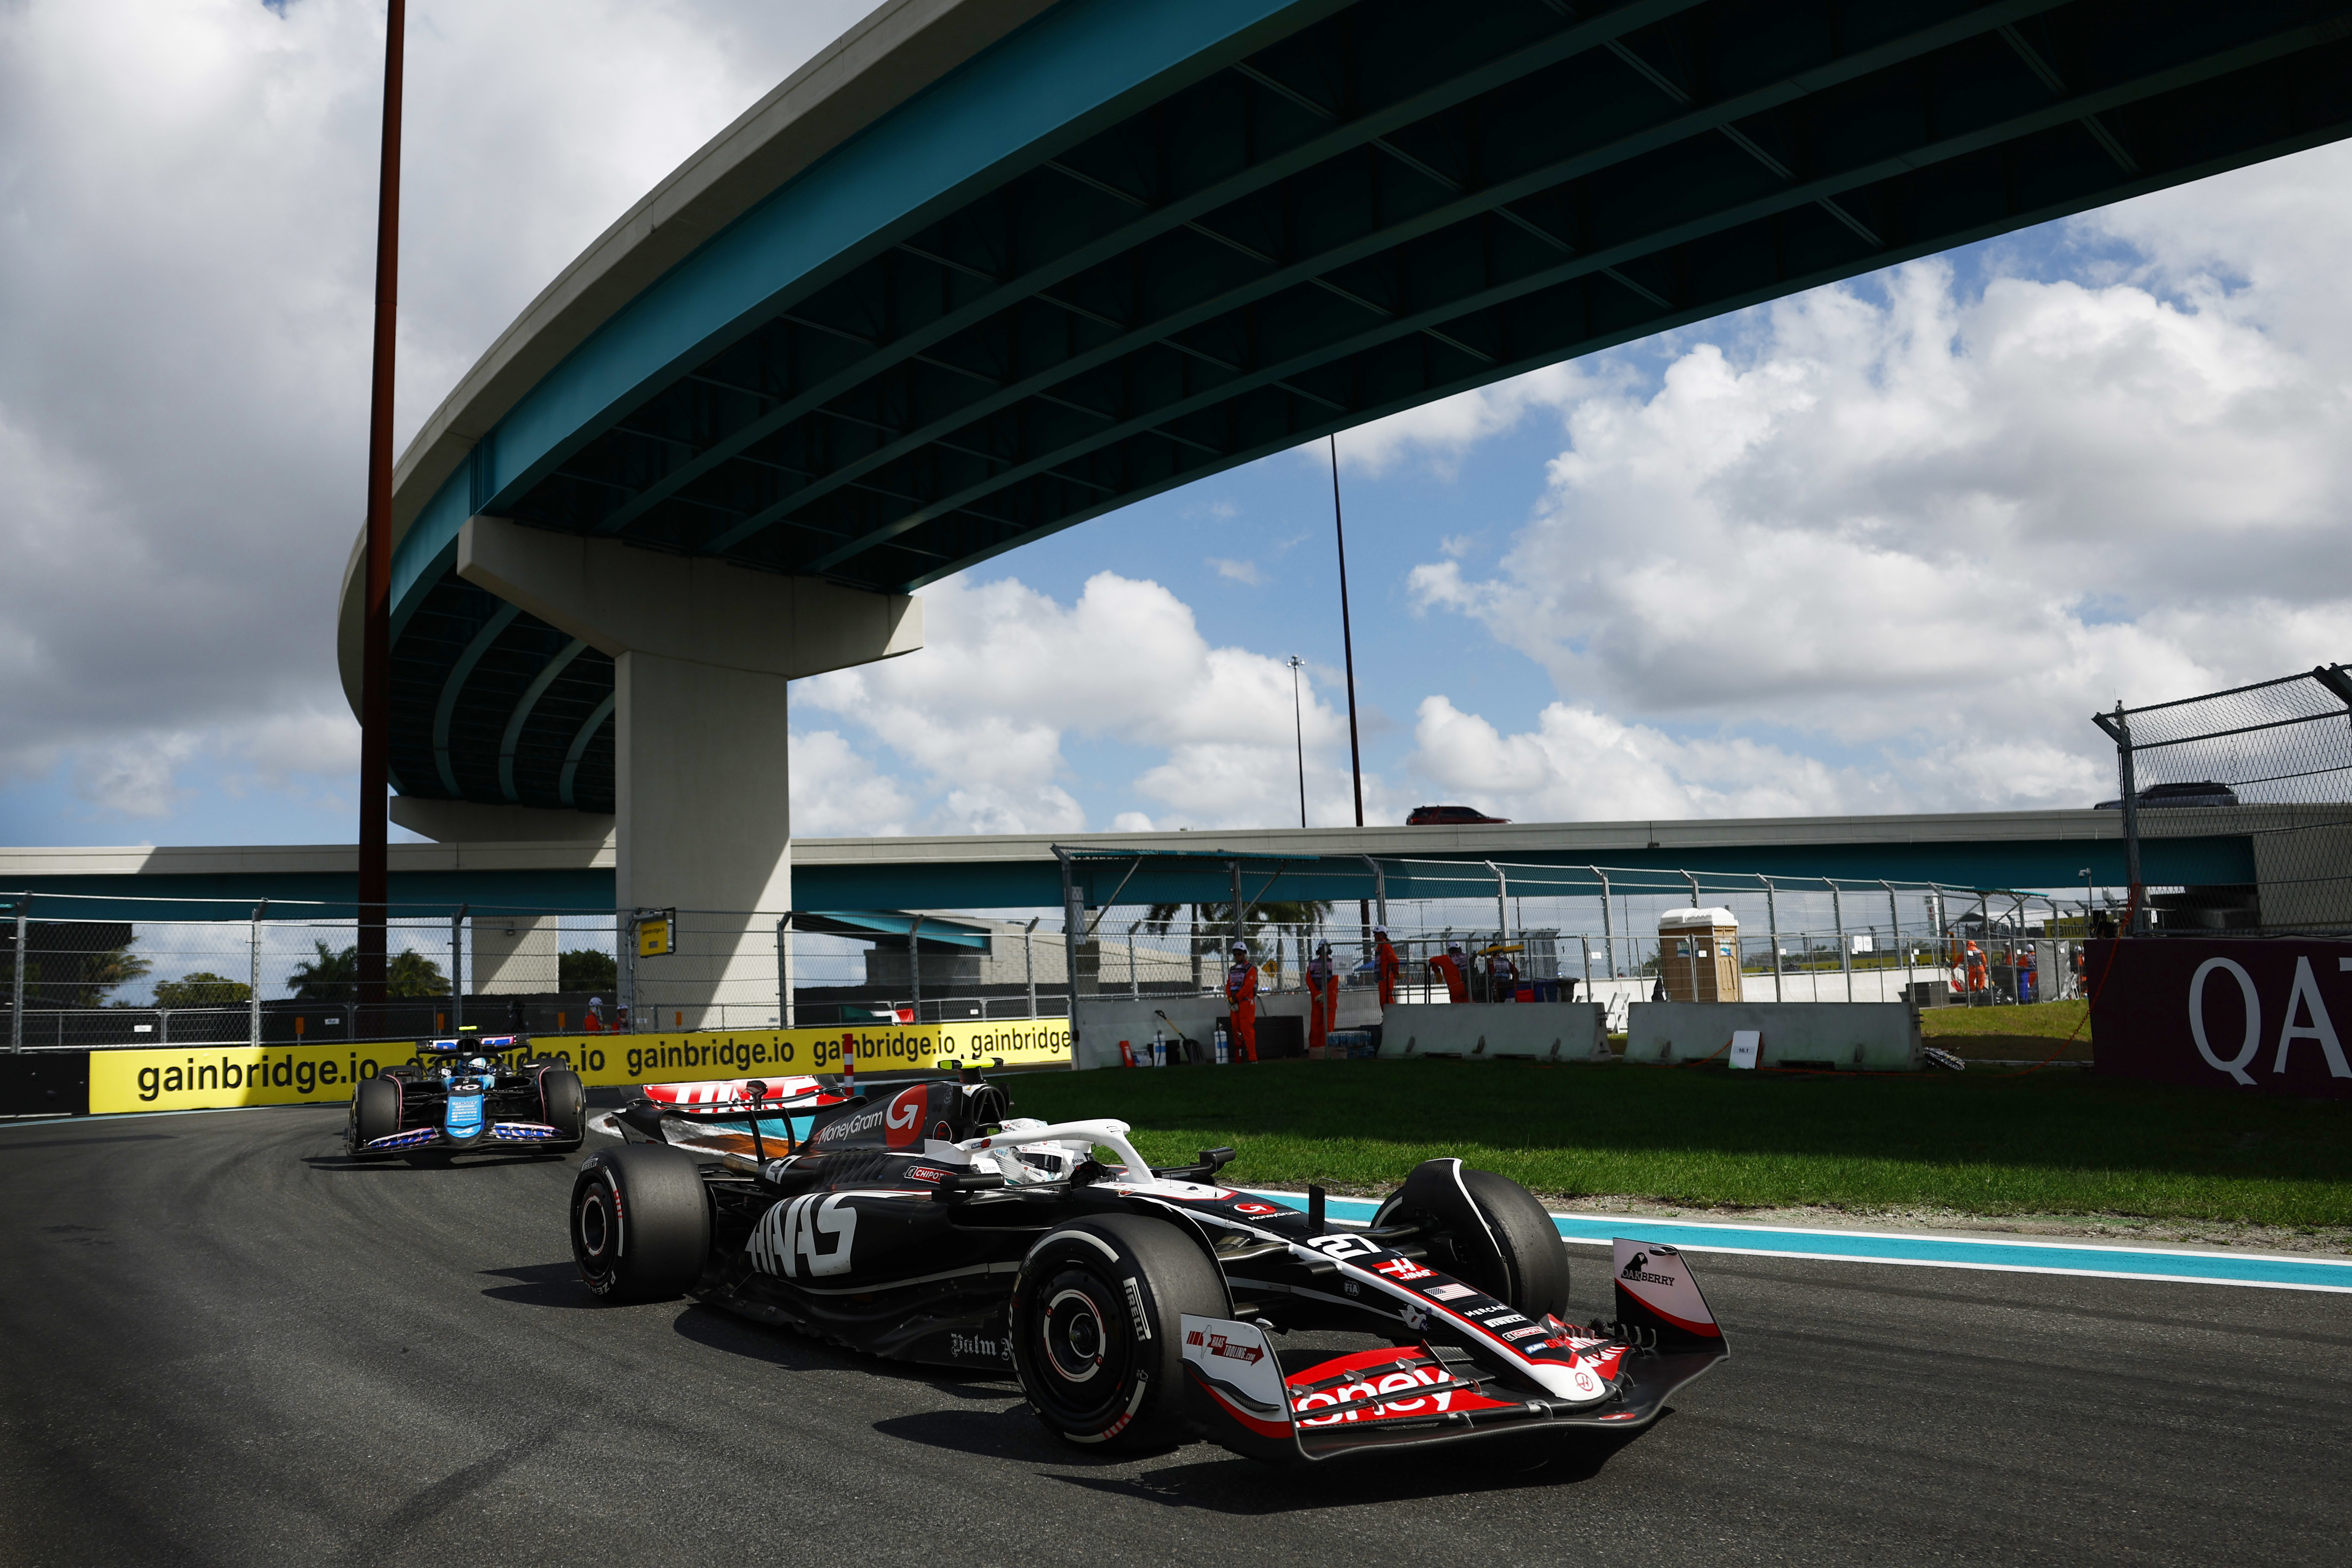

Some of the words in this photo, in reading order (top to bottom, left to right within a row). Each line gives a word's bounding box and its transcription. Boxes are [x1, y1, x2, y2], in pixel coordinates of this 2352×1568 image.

[627, 1037, 794, 1077] gainbridge.io
[138, 1053, 378, 1101] gainbridge.io
[817, 1110, 883, 1145] MoneyGram
[581, 1157, 598, 1172] PIRELLI
[917, 1169, 942, 1180] CHIPOT
[1248, 1210, 1300, 1221] MoneyGram
[1307, 1234, 1382, 1260] 27
[1622, 1268, 1675, 1286] OAKBERRY
[1123, 1277, 1152, 1341] PIRELLI
[1483, 1314, 1528, 1328] PIRELLI
[1515, 1327, 1546, 1337] CHIPOTLE
[950, 1332, 998, 1357] Palm
[1211, 1336, 1225, 1348] HAAS
[1544, 1338, 1562, 1349] GO
[1223, 1345, 1256, 1361] TOOLING.COM
[1290, 1370, 1452, 1428] oney
